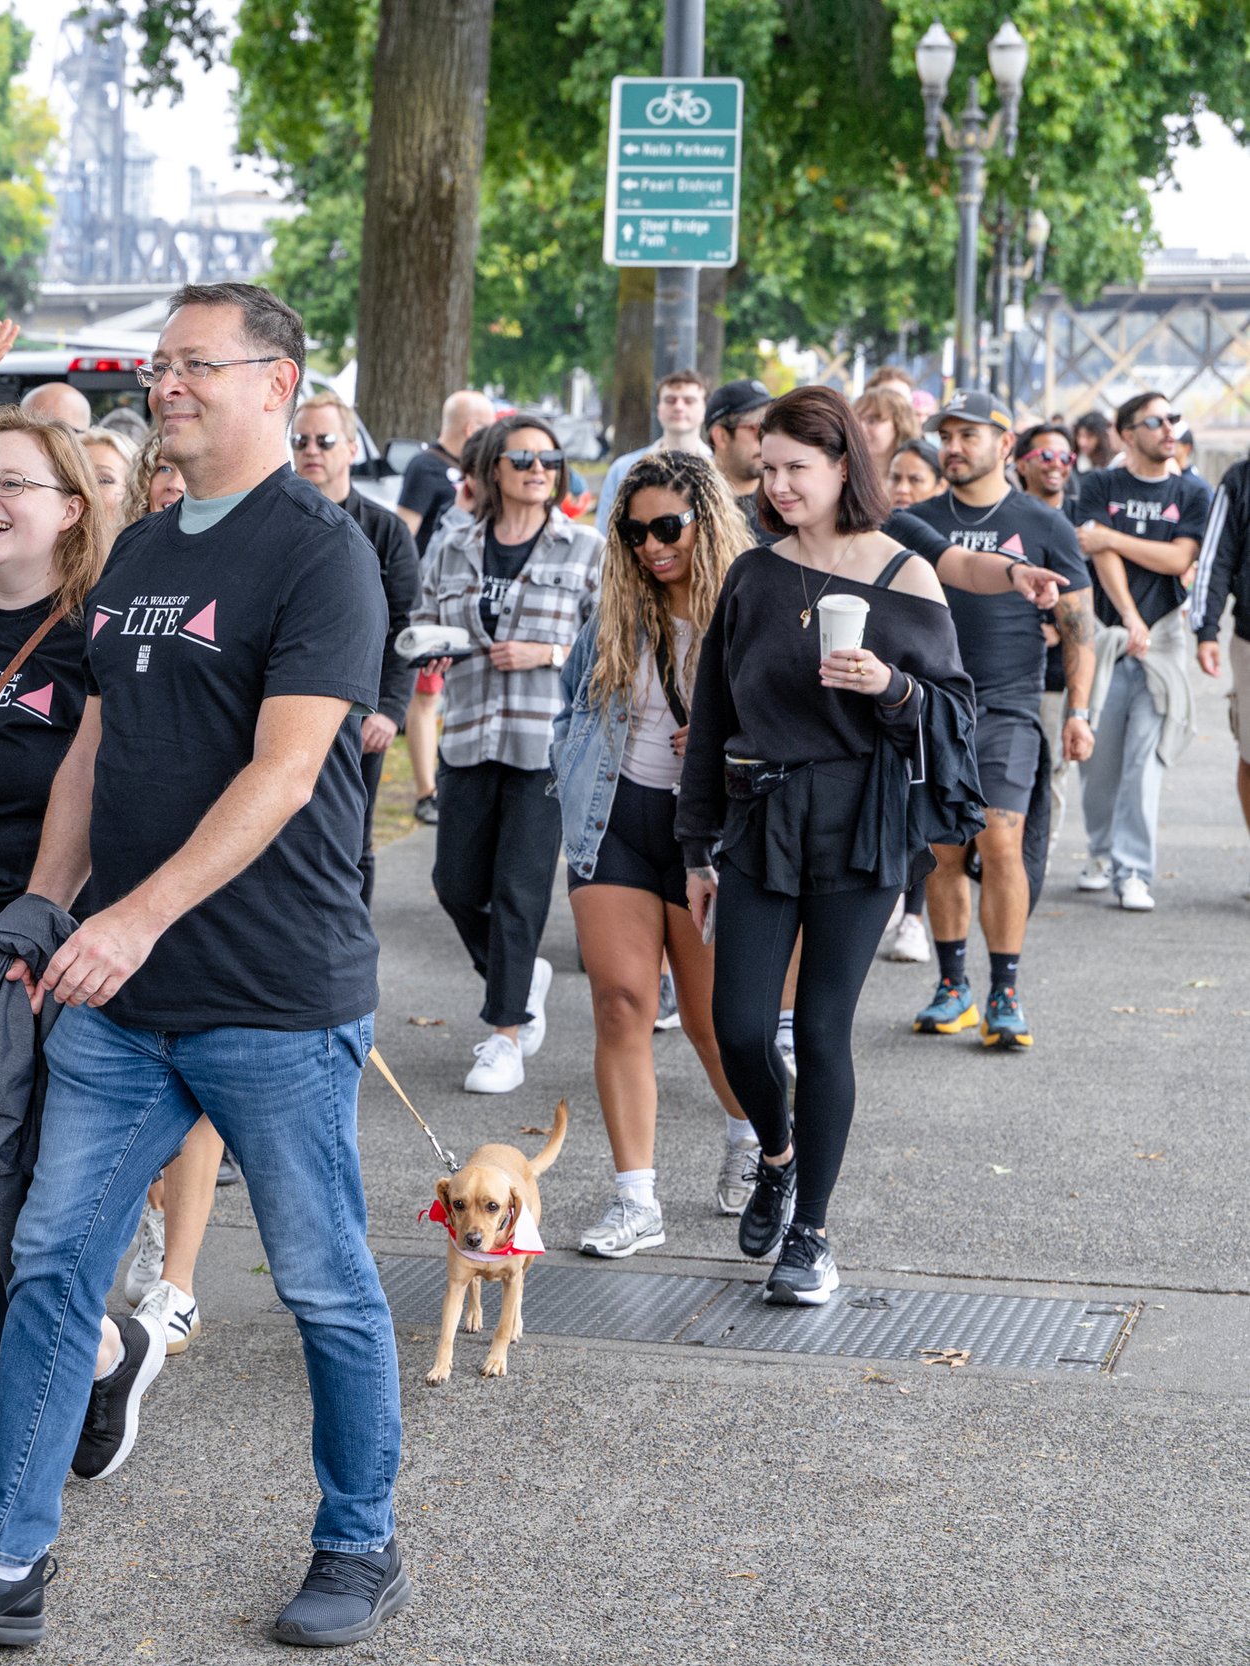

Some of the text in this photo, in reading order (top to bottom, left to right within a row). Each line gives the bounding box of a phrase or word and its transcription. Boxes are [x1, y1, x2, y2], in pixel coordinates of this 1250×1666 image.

[675, 142, 726, 159] Parkway
[641, 178, 723, 192] Pearl District
[639, 218, 709, 236] Steel Bridge
[639, 234, 666, 247] Path
[131, 595, 190, 606] ALL WALKS OF
[120, 607, 183, 636] LIFE
